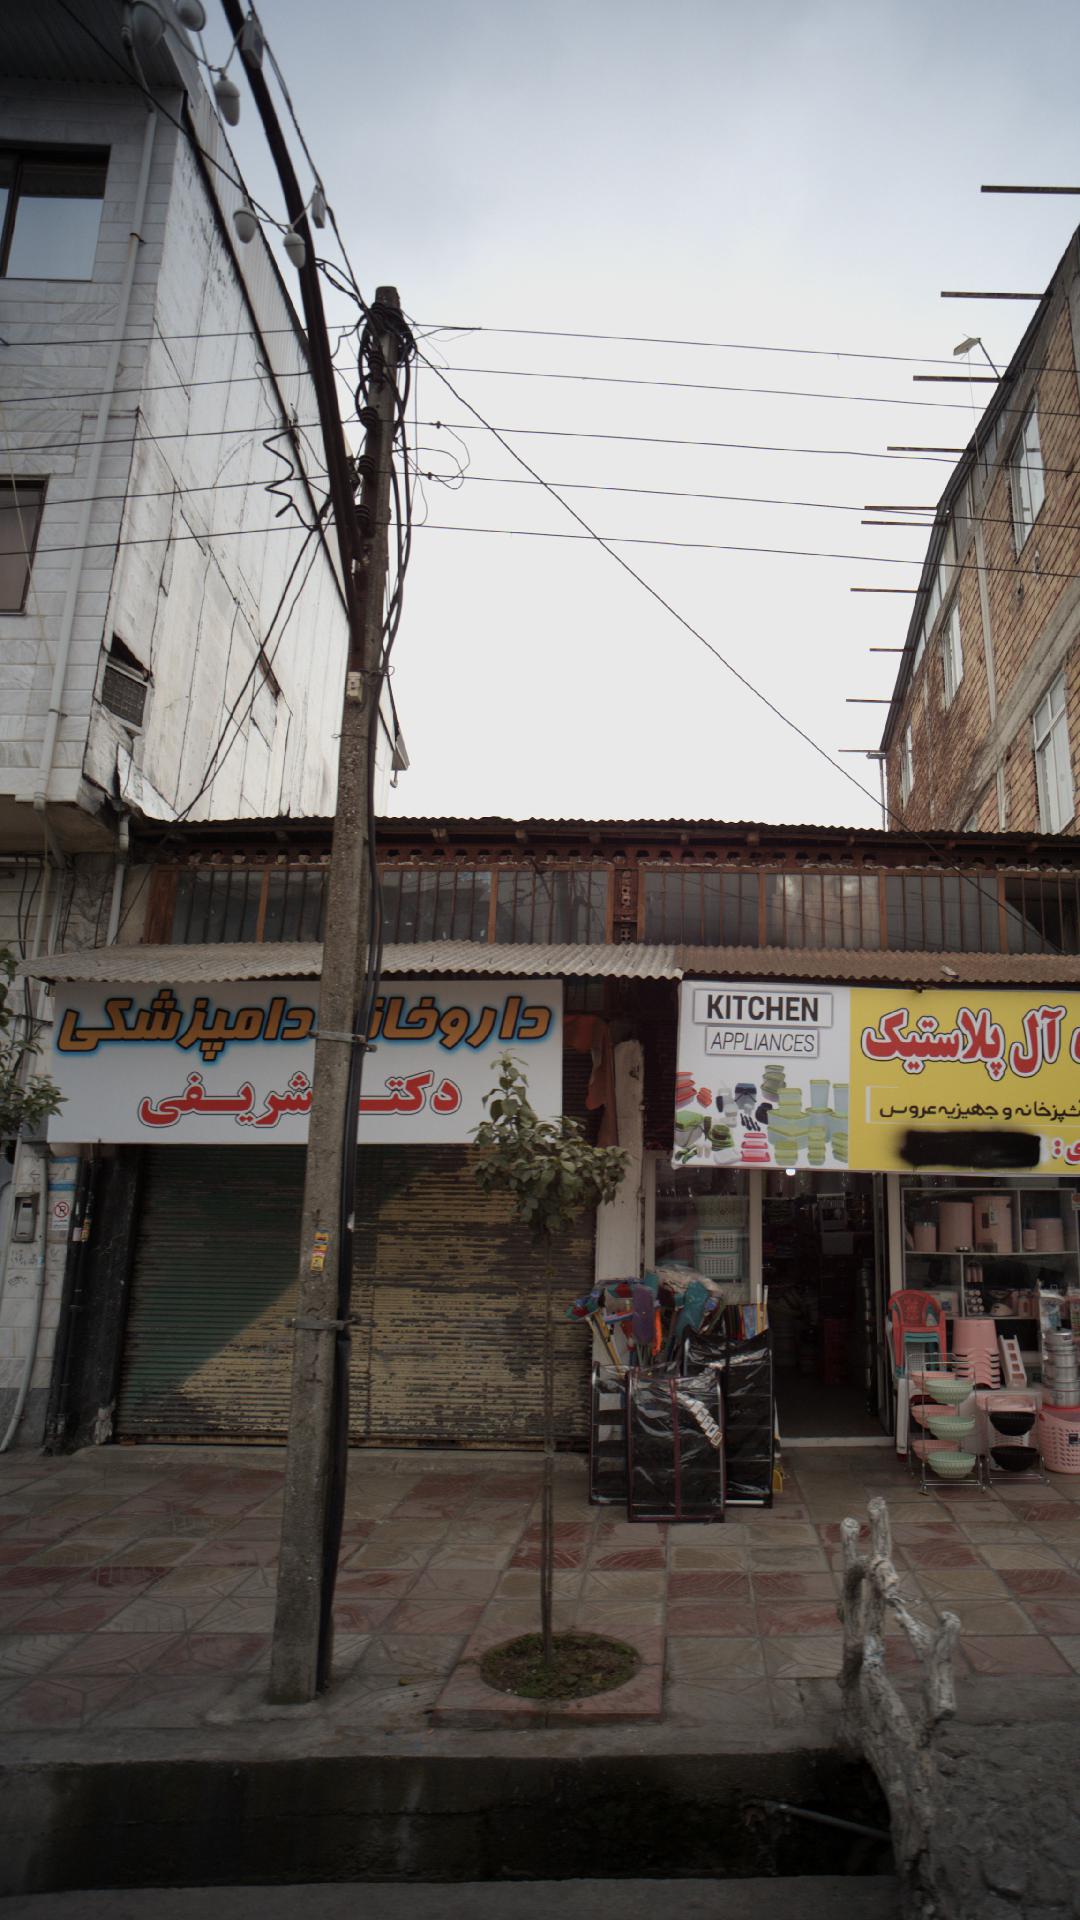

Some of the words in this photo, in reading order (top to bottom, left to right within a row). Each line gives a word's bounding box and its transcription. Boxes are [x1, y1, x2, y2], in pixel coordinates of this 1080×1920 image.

[57, 988, 316, 1061] دامپزشکی
[367, 996, 553, 1050] داروخان
[707, 994, 818, 1022] KITCHEN
[710, 1032, 815, 1052] APPLIANCES
[861, 1007, 1008, 1081] پلاستیک
[1009, 1005, 1067, 1078] آل
[137, 1071, 313, 1128] شریفی
[359, 1070, 463, 1115] دکت
[879, 1104, 937, 1119] عروس
[938, 1103, 999, 1119] جهیزیه
[1002, 1107, 1013, 1120] و
[1015, 1099, 1080, 1123] شپزخانه
